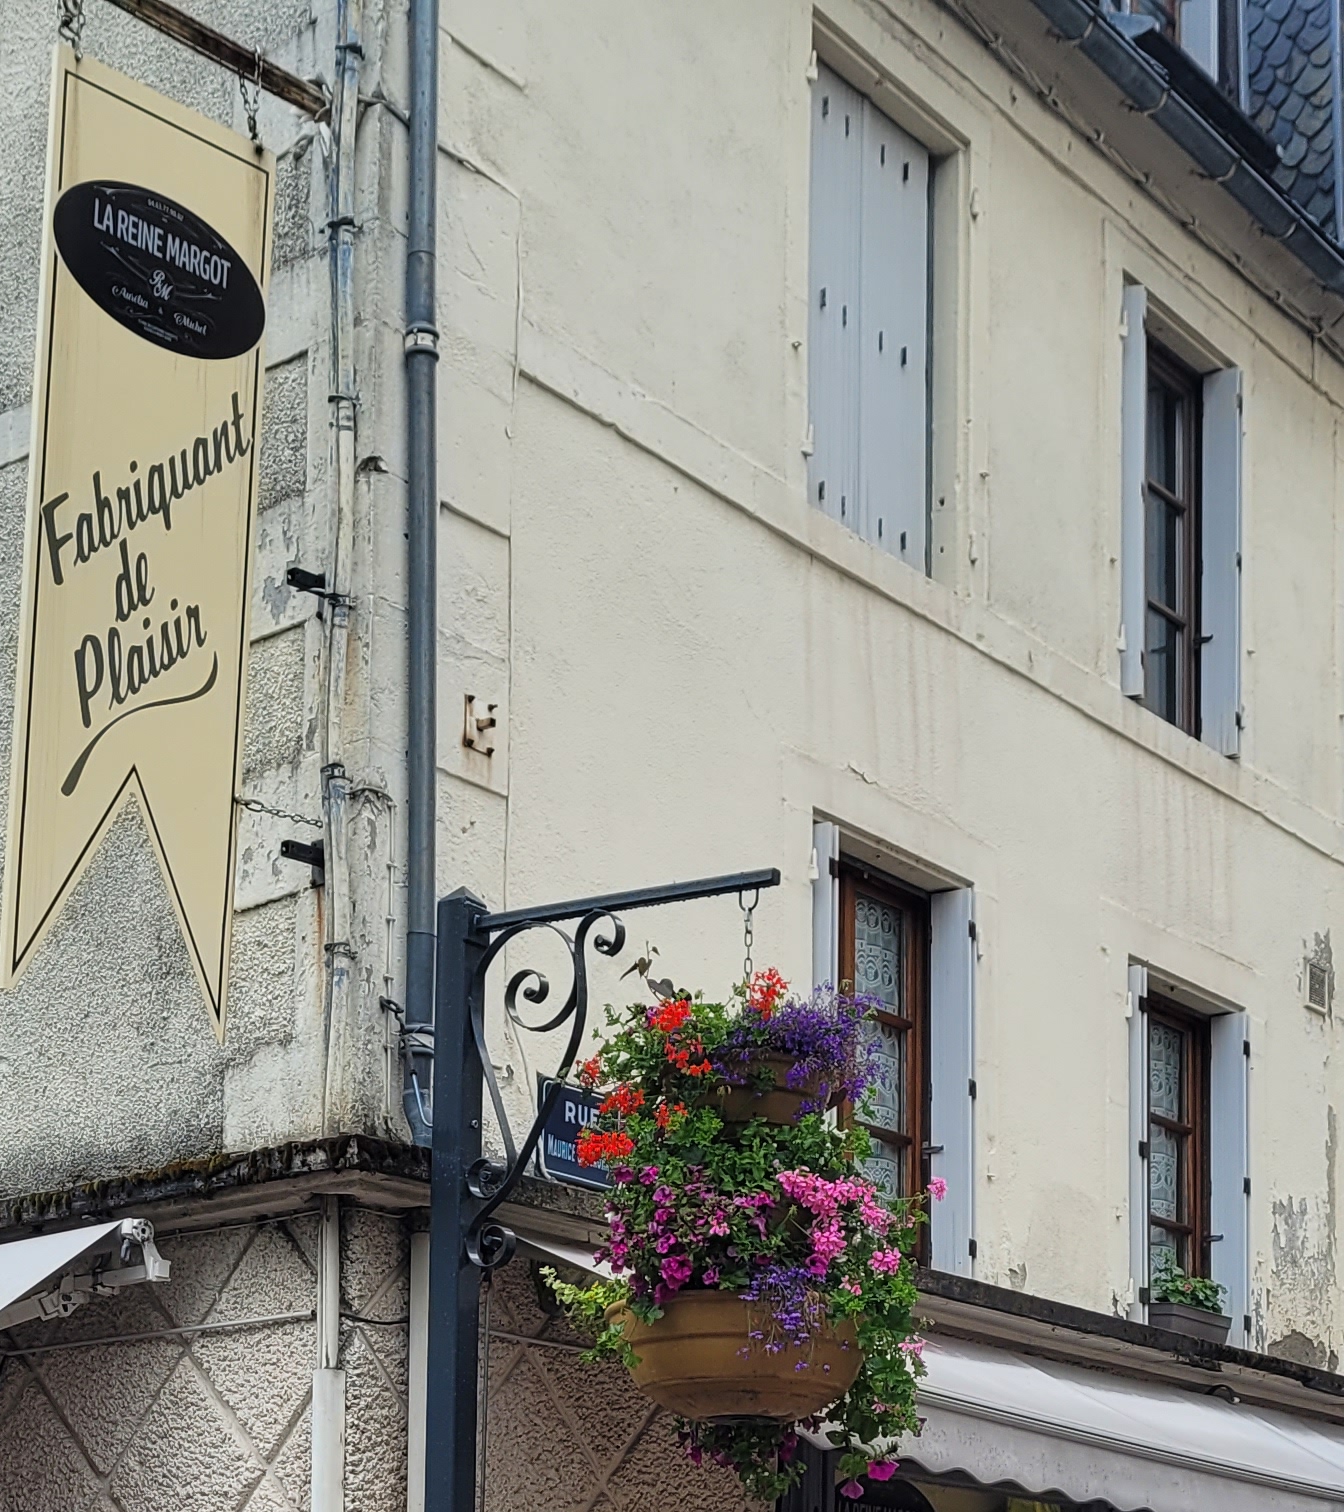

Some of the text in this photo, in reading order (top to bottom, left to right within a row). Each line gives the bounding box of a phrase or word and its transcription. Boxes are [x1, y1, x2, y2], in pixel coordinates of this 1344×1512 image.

[93, 198, 114, 235] LA
[117, 209, 164, 258] REINE
[165, 233, 231, 289] MARGOT
[40, 391, 250, 585] Fabriquant
[114, 539, 155, 623] de
[73, 598, 208, 727] Plaisir
[547, 1134, 576, 1162] MAURICE
